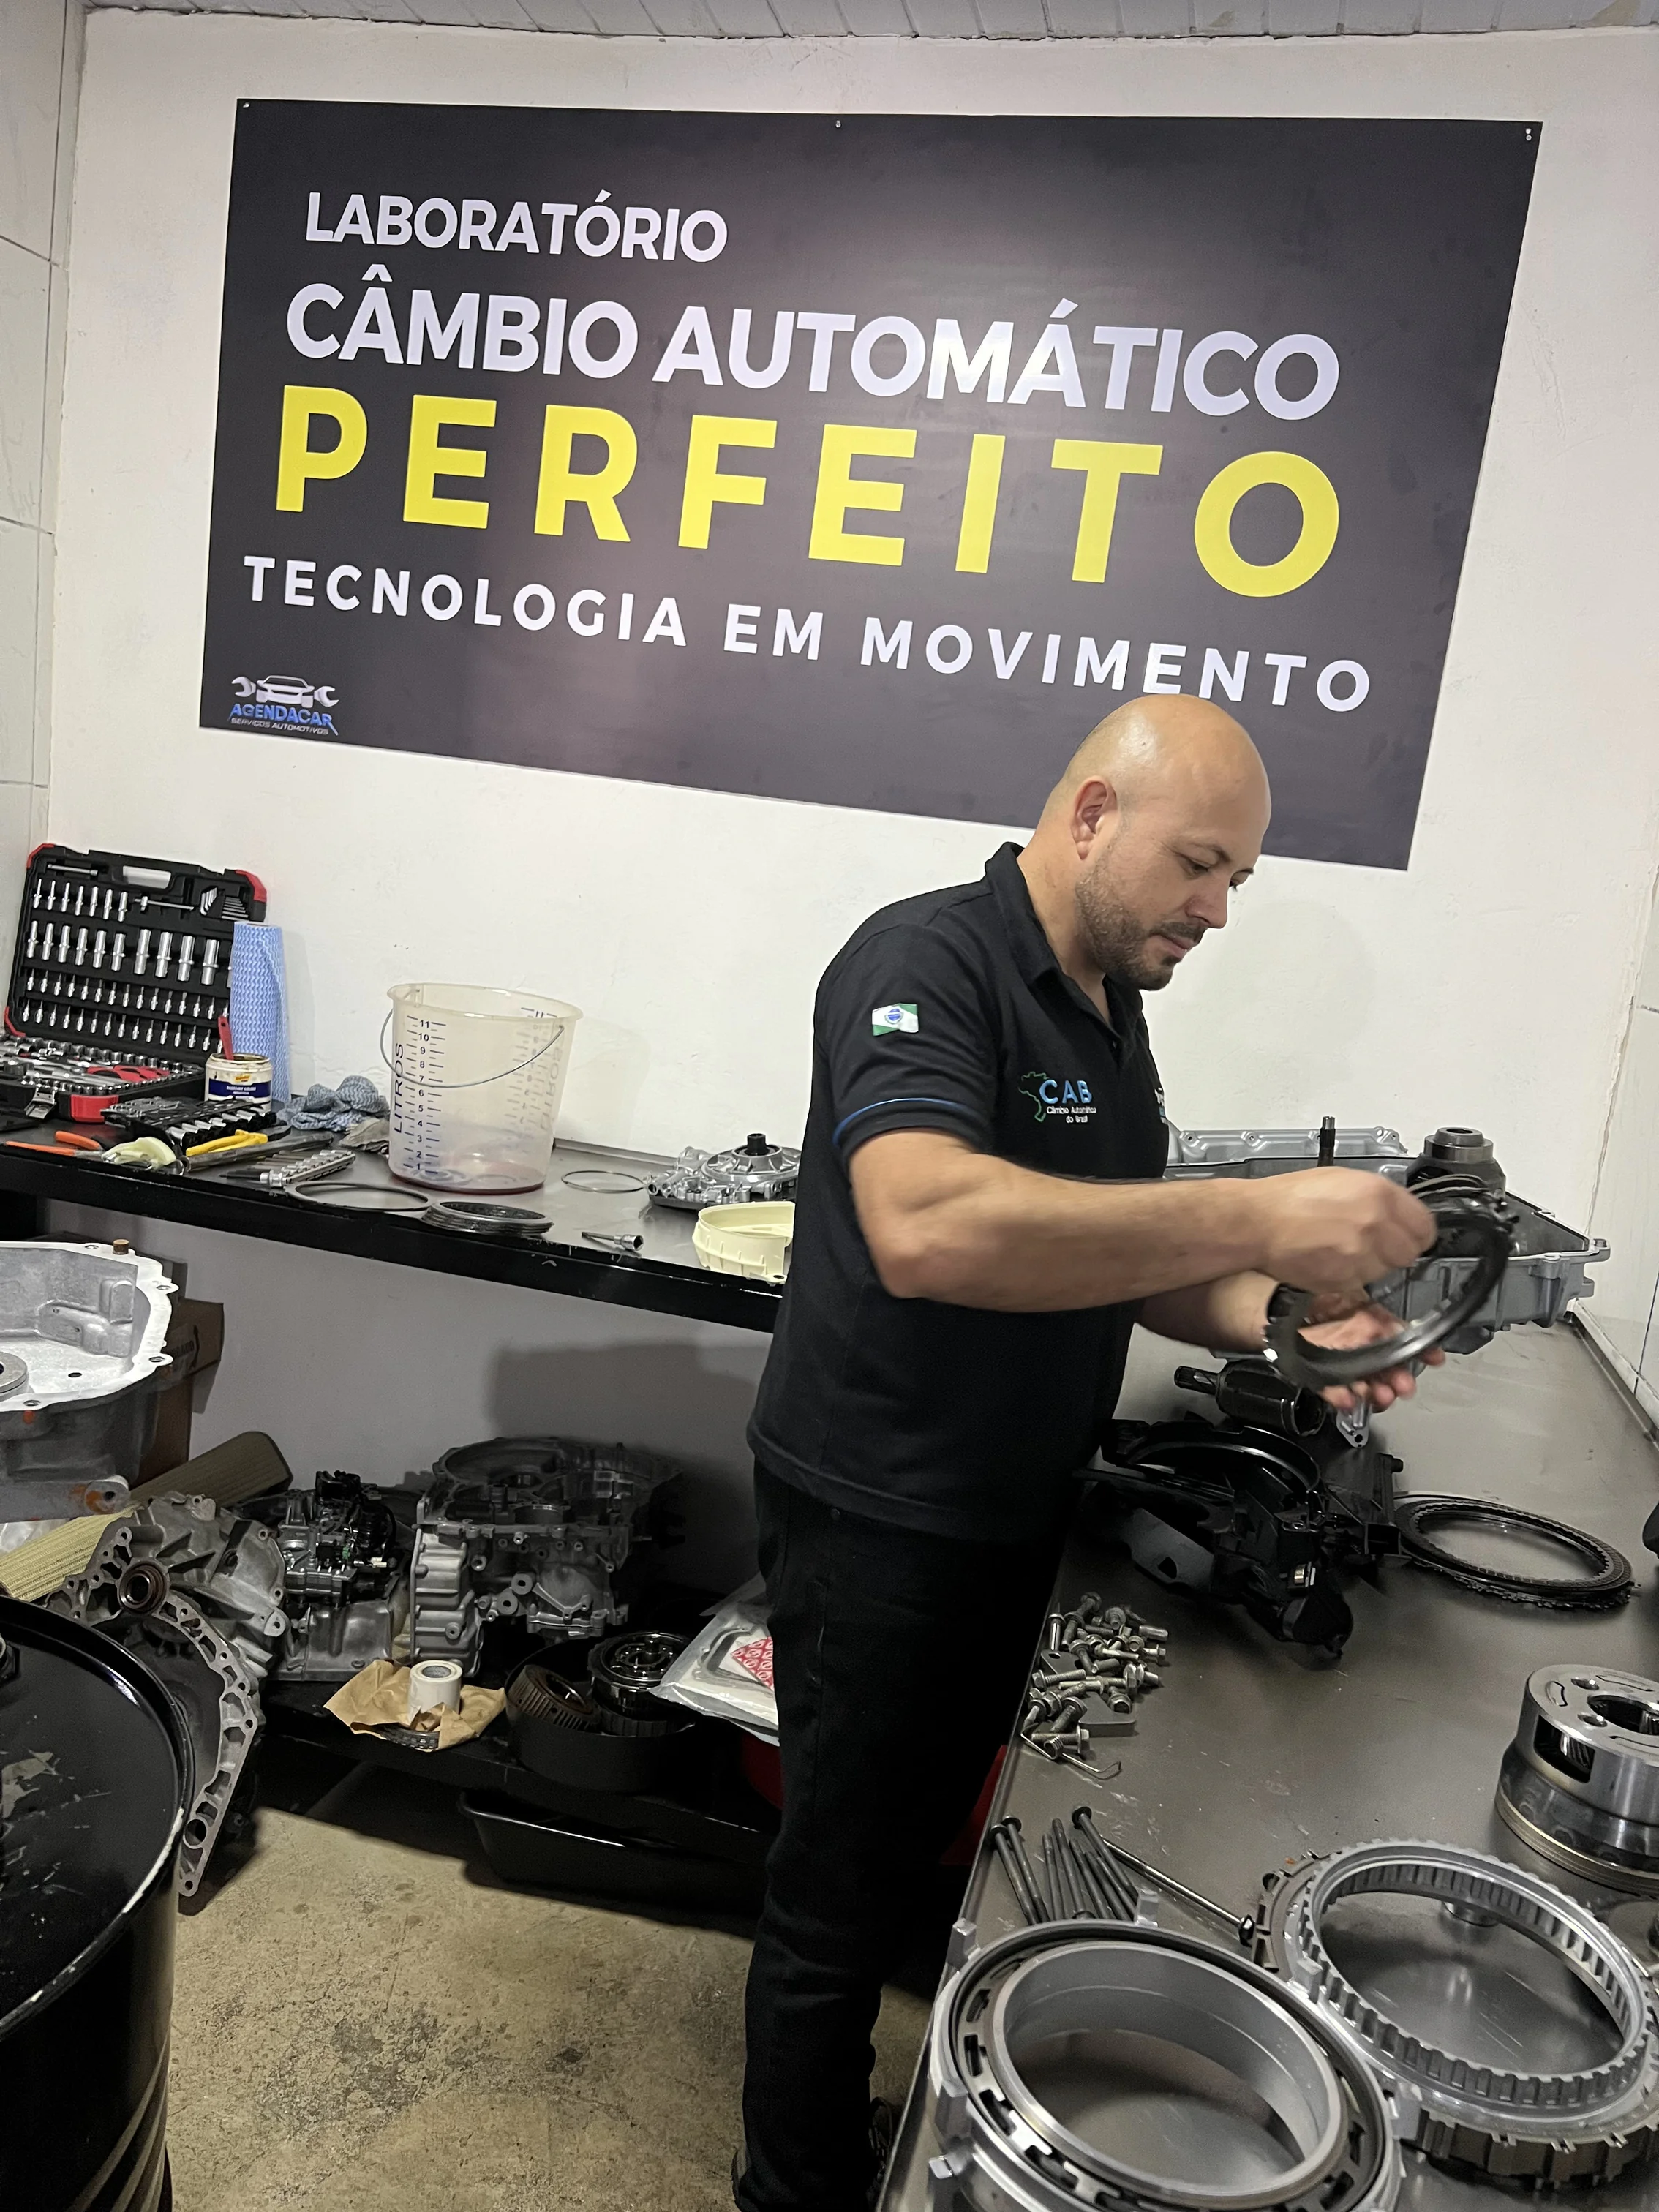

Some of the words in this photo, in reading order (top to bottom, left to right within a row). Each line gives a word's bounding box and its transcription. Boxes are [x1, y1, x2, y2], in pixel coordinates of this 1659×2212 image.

[306, 189, 728, 263] LABORATÓRIO
[287, 264, 638, 379] CÂMBIO
[652, 298, 1339, 421] AUTOMÁTICO
[276, 385, 1339, 598] PERFEITO
[244, 555, 687, 647] TECNOLOGIA
[723, 603, 824, 661] EM
[860, 617, 1369, 712] MOVIMENTO
[228, 703, 339, 736] AGENDACAR
[271, 721, 329, 735] AUTOMOTIVOS
[419, 1020, 429, 1028] 11
[418, 1032, 429, 1042] 10
[420, 1046, 426, 1055] 9
[419, 1060, 425, 1069] 8
[419, 1075, 424, 1083] 7
[394, 1042, 403, 1133] LITROS
[1039, 1079, 1093, 1105] CAB
[418, 1089, 424, 1097] 6
[418, 1105, 424, 1113] 5
[1066, 1115, 1074, 1124] do
[417, 1135, 422, 1143] 3
[416, 1151, 422, 1159] 2
